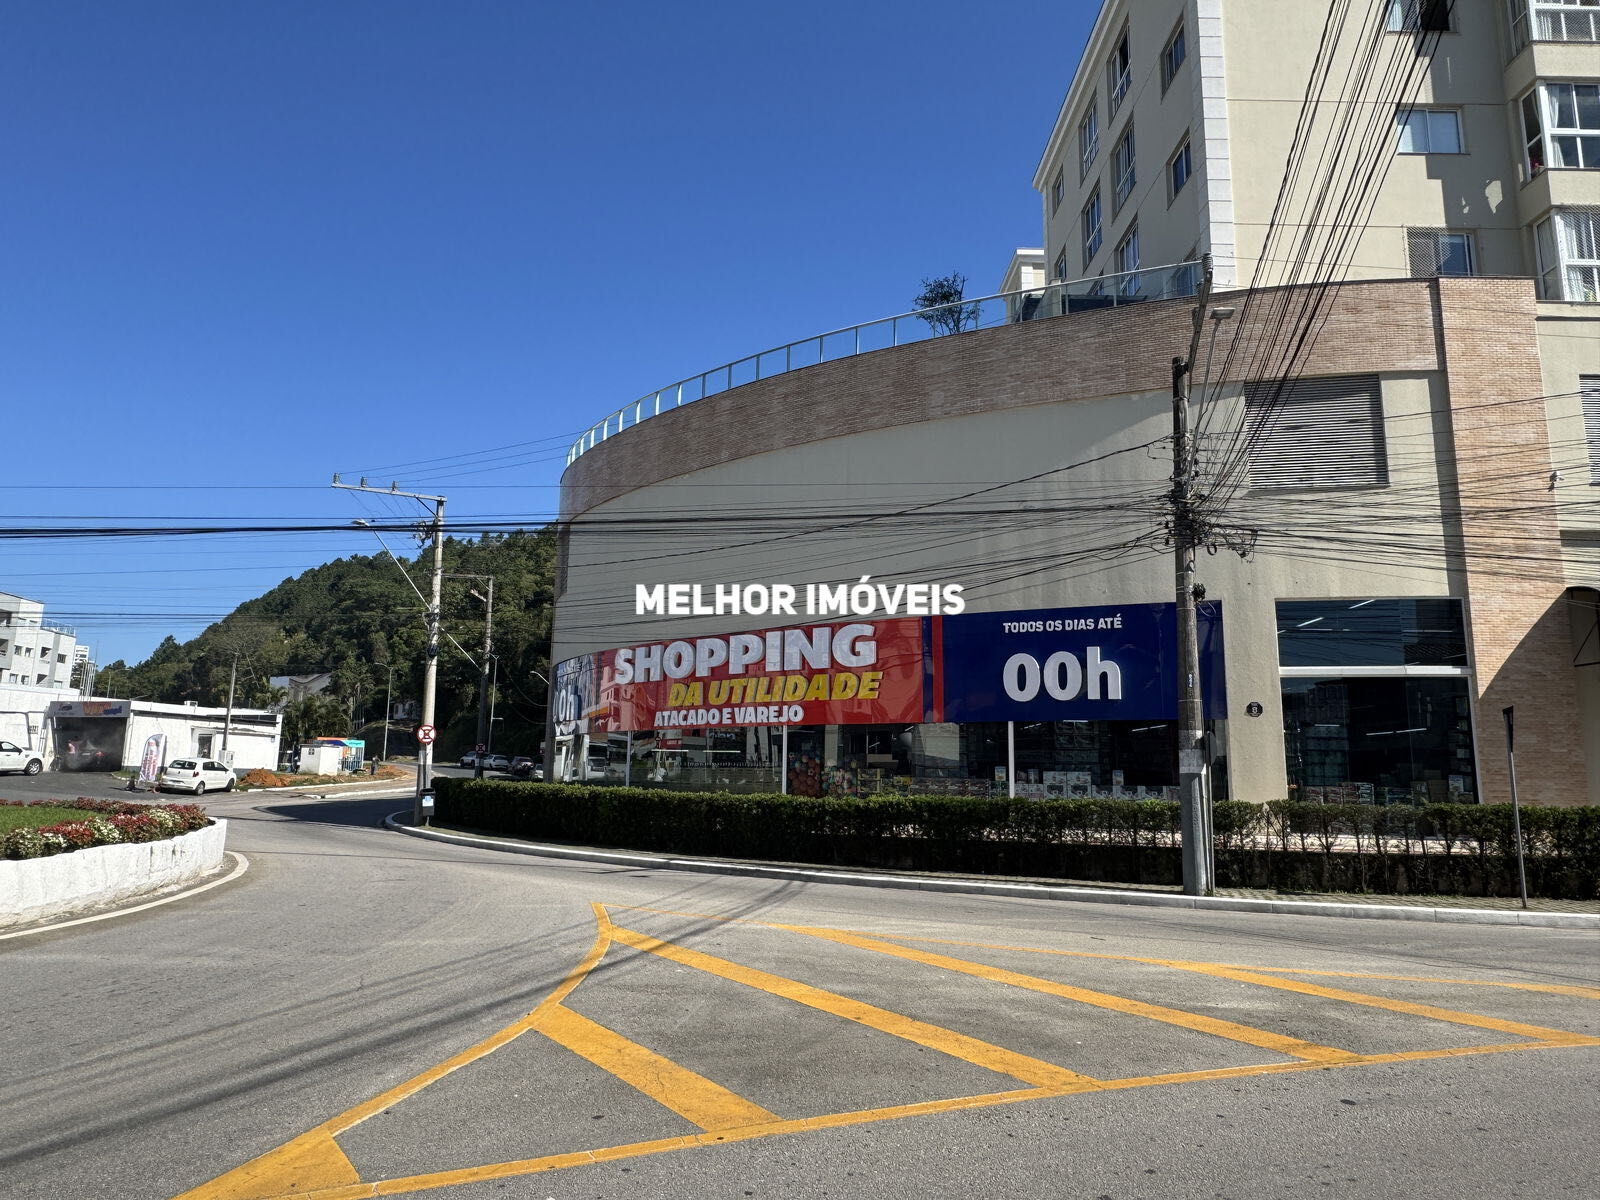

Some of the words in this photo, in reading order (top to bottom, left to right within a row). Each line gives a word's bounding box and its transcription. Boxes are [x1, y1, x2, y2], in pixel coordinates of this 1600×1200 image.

[1003, 620, 1044, 633] TODOS
[1046, 619, 1063, 632] OS
[1065, 618, 1095, 631] DIAS
[1098, 613, 1122, 629] ATÉ
[614, 623, 877, 685] SHOPPING
[666, 681, 704, 707] DA
[708, 671, 884, 706] UTILIDADE
[1003, 646, 1122, 702] 00h
[654, 708, 721, 727] ATACADO
[722, 707, 733, 725] E
[733, 704, 804, 725] VAREJO
